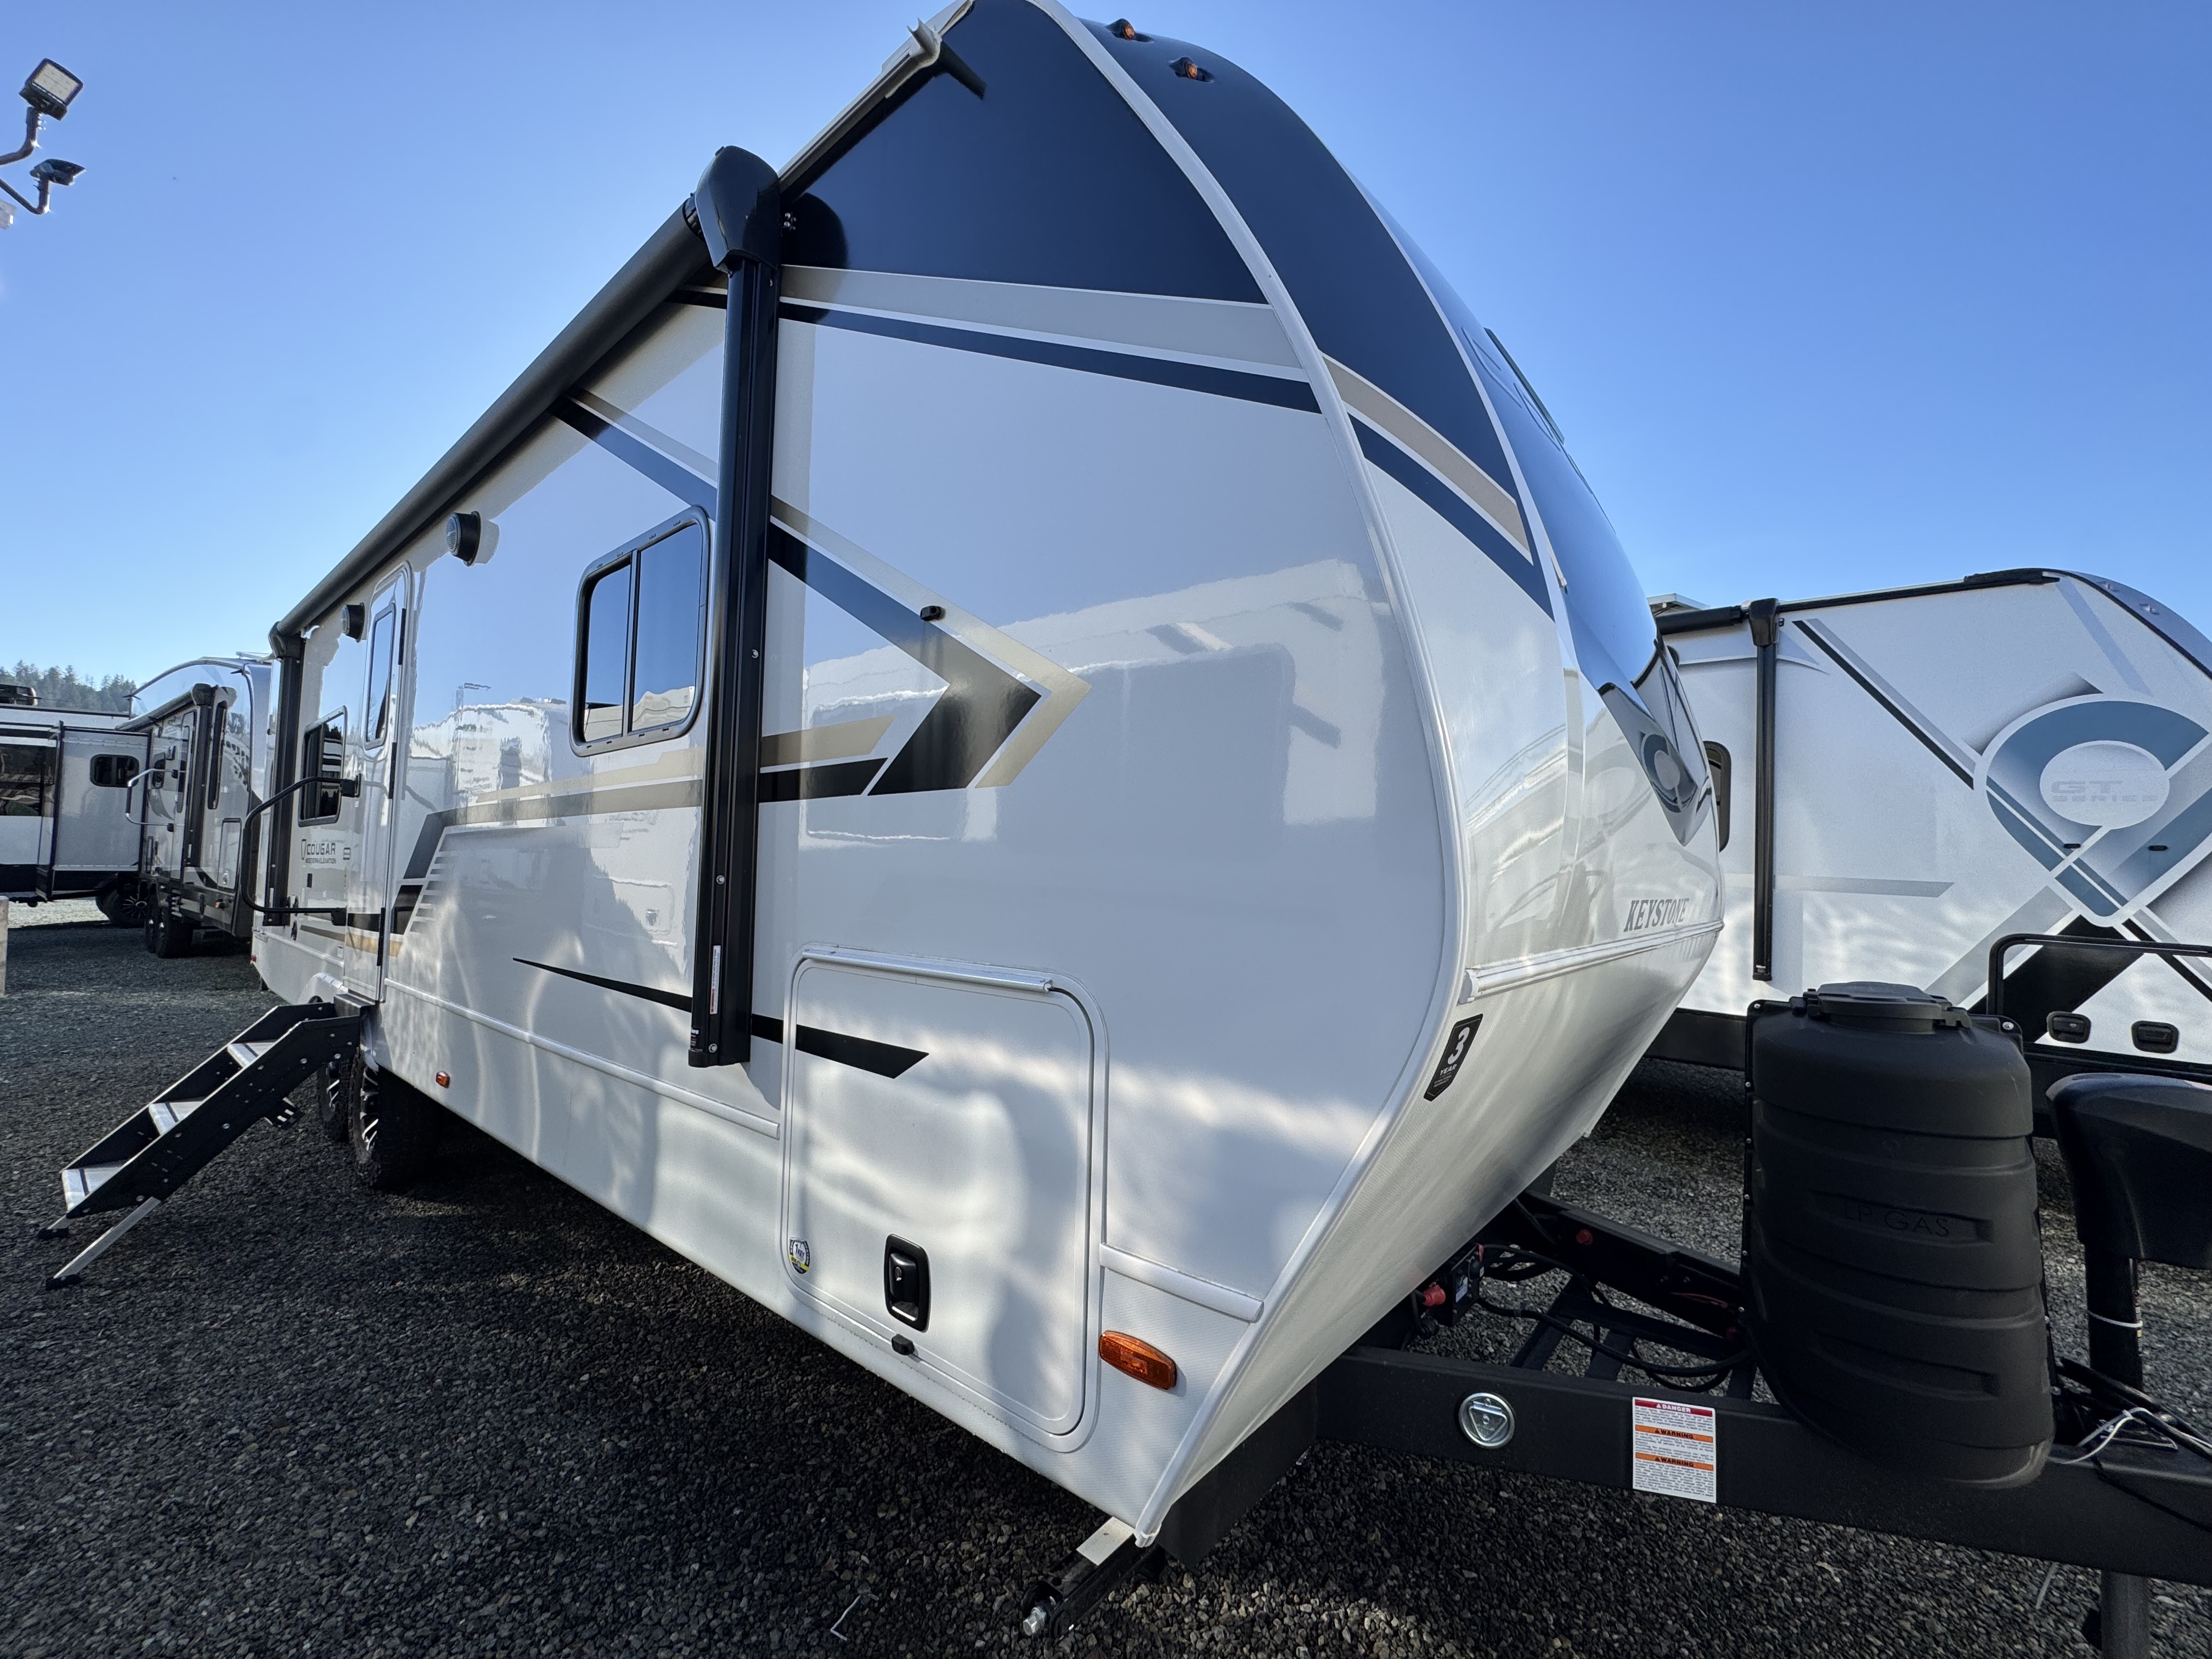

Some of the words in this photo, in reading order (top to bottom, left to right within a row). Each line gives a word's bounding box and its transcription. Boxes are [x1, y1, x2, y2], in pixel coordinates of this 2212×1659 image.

[2051, 781, 2124, 794] GT
[307, 843, 336, 855] COUGAR
[1624, 898, 1690, 932] KEYSTONE
[1447, 1026, 1470, 1064] 3
[1884, 1210, 1949, 1237] GAS
[1662, 1404, 1691, 1413] DANGER
[1661, 1429, 1694, 1439] WARNING
[1661, 1457, 1694, 1467] WARNING
